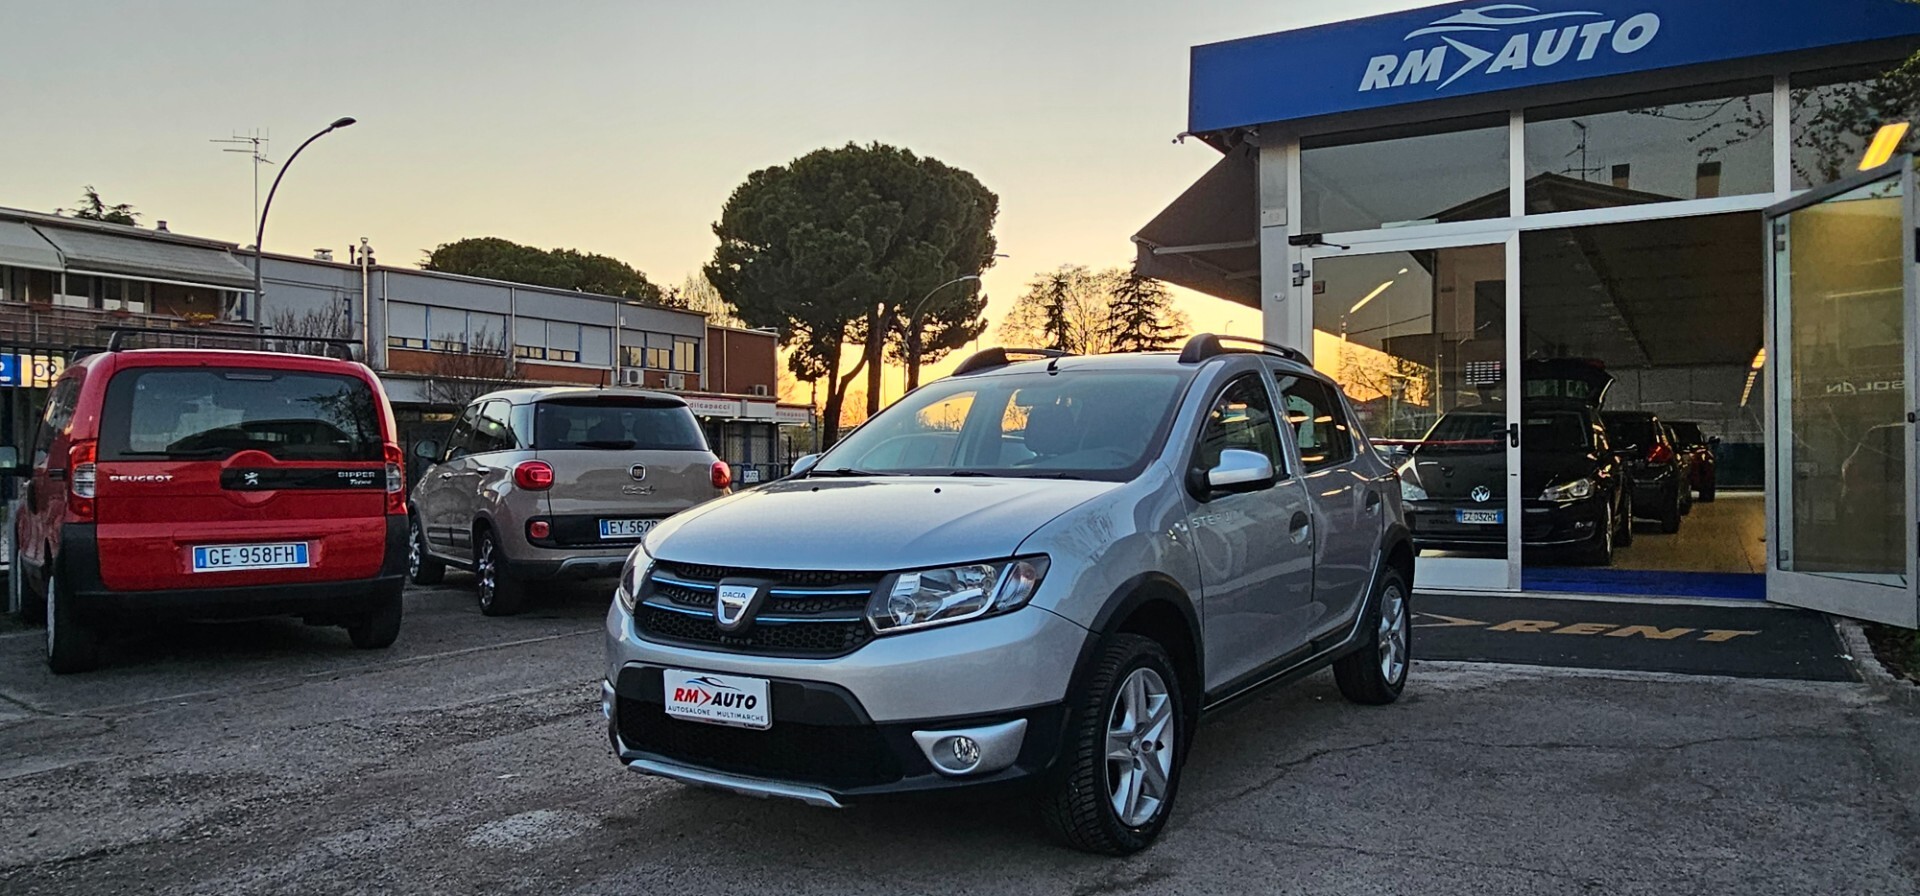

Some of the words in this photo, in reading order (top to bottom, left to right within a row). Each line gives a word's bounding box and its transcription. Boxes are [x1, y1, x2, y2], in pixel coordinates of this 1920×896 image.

[1485, 12, 1660, 74] AUTO
[209, 549, 231, 565] GE
[239, 546, 295, 563] 958FH
[722, 591, 746, 599] DACIA
[1486, 619, 1762, 642] RENT
[711, 692, 757, 710] AUTO
[668, 705, 710, 715] AUTOSALONE
[717, 711, 764, 722] MULTIMARCHE
